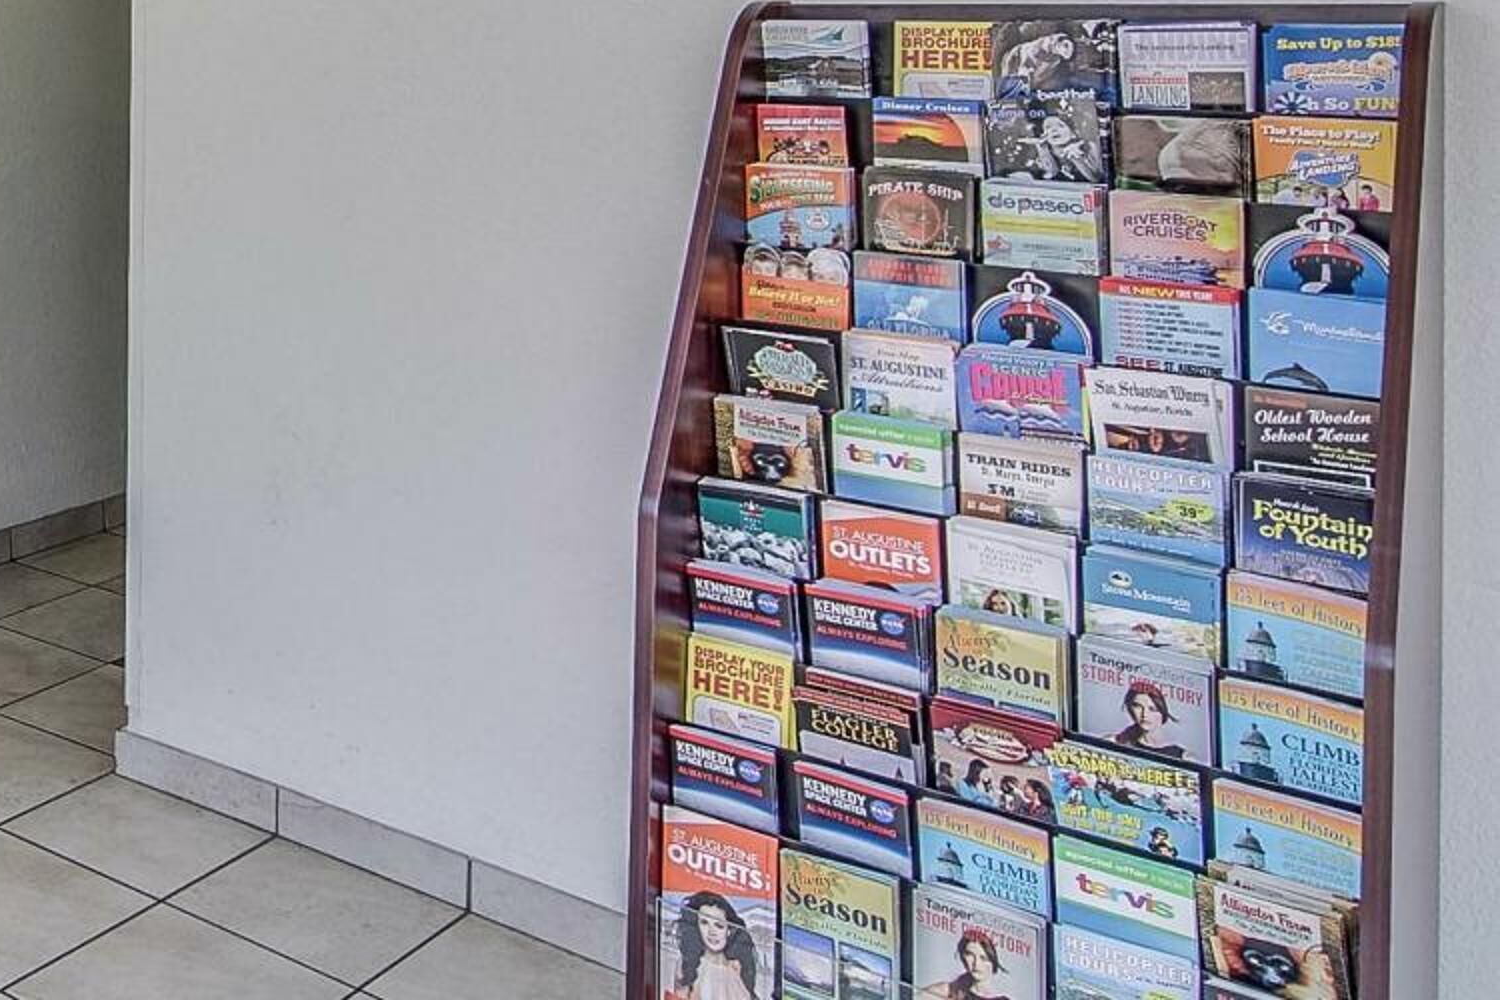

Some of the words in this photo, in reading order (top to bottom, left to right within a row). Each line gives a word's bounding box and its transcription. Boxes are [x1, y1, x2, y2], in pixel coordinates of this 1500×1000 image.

[902, 27, 955, 38] DISPLAY
[902, 38, 992, 50] BROCHURE
[1276, 37, 1316, 51] Save
[1319, 37, 1343, 51] Up
[1347, 38, 1363, 49] to
[902, 50, 993, 70] HERE!
[882, 101, 922, 112] Dinner
[925, 102, 970, 113] Cruises
[1323, 97, 1349, 111] So
[1263, 125, 1287, 136] The
[1289, 125, 1324, 138] Place
[1328, 128, 1341, 138] to
[868, 181, 923, 197] PIRATE
[927, 182, 963, 200] SHIP
[1123, 213, 1218, 233] RIVERBOAT
[1133, 225, 1207, 242] CRUISES
[1131, 285, 1176, 299] NEW
[870, 359, 949, 381] AUGUSTINE
[1117, 380, 1168, 399] Sebastian
[1168, 384, 1210, 407] Winery
[1254, 409, 1302, 425] Oldest
[1305, 409, 1372, 425] Wooden
[1261, 427, 1312, 443] School
[1316, 427, 1371, 443] House
[846, 443, 926, 473] tervis
[966, 453, 1017, 470] TRAIN
[1020, 460, 1072, 478] RIDES
[1092, 459, 1213, 490] HELICOPTER
[1252, 498, 1373, 543] Fountain
[832, 525, 852, 539] ST.
[853, 530, 925, 553] AUGUSTINE
[1259, 522, 1285, 540] of
[1288, 524, 1368, 560] Youth
[829, 541, 931, 576] OUTLETS
[695, 578, 754, 601] KENNEDY
[695, 589, 724, 603] SPACE
[724, 594, 755, 610] CENTER
[698, 603, 732, 618] ALWAYS
[733, 610, 781, 627] EXPLORING
[813, 598, 877, 621] KENNEDY
[815, 612, 843, 626] SPACE
[843, 616, 879, 632] CENTER
[816, 625, 853, 640] ALWAYS
[855, 631, 907, 650] EXPLORING
[694, 645, 746, 667] DISPLAY
[750, 659, 785, 678] YOUR
[942, 645, 1051, 691] Season
[693, 669, 784, 712] HERE!
[1081, 663, 1124, 687] STORE
[1128, 674, 1204, 707] DIRECTORY
[810, 707, 899, 743] FLAGLER
[1252, 695, 1280, 713] feet
[1284, 704, 1300, 720] of
[1306, 707, 1358, 740] History
[810, 719, 900, 752] COLLEGE
[675, 739, 736, 766] KENNEDY
[1280, 732, 1361, 767] CLIMB
[677, 754, 703, 768] SPACE
[703, 759, 736, 777] CENTER
[678, 766, 714, 784] ALWAYS
[715, 778, 763, 797] EXPLORING
[803, 776, 867, 805] KENNEDY
[803, 789, 832, 806] SPACE
[832, 798, 867, 816] CENTER
[806, 803, 845, 821] ALWAYS
[845, 811, 897, 838] EXPLORING
[671, 827, 690, 842] ST.
[691, 834, 759, 864] AUGUSTINE
[667, 843, 764, 890] OUTLETS
[971, 852, 1039, 885] CLIMB
[785, 882, 887, 935] Season
[1076, 873, 1175, 919] tervis
[1220, 892, 1275, 922] Alligator
[916, 907, 957, 935] STORE
[961, 922, 1031, 957] DIRECTORY
[1064, 934, 1192, 986] HELICOPTER
